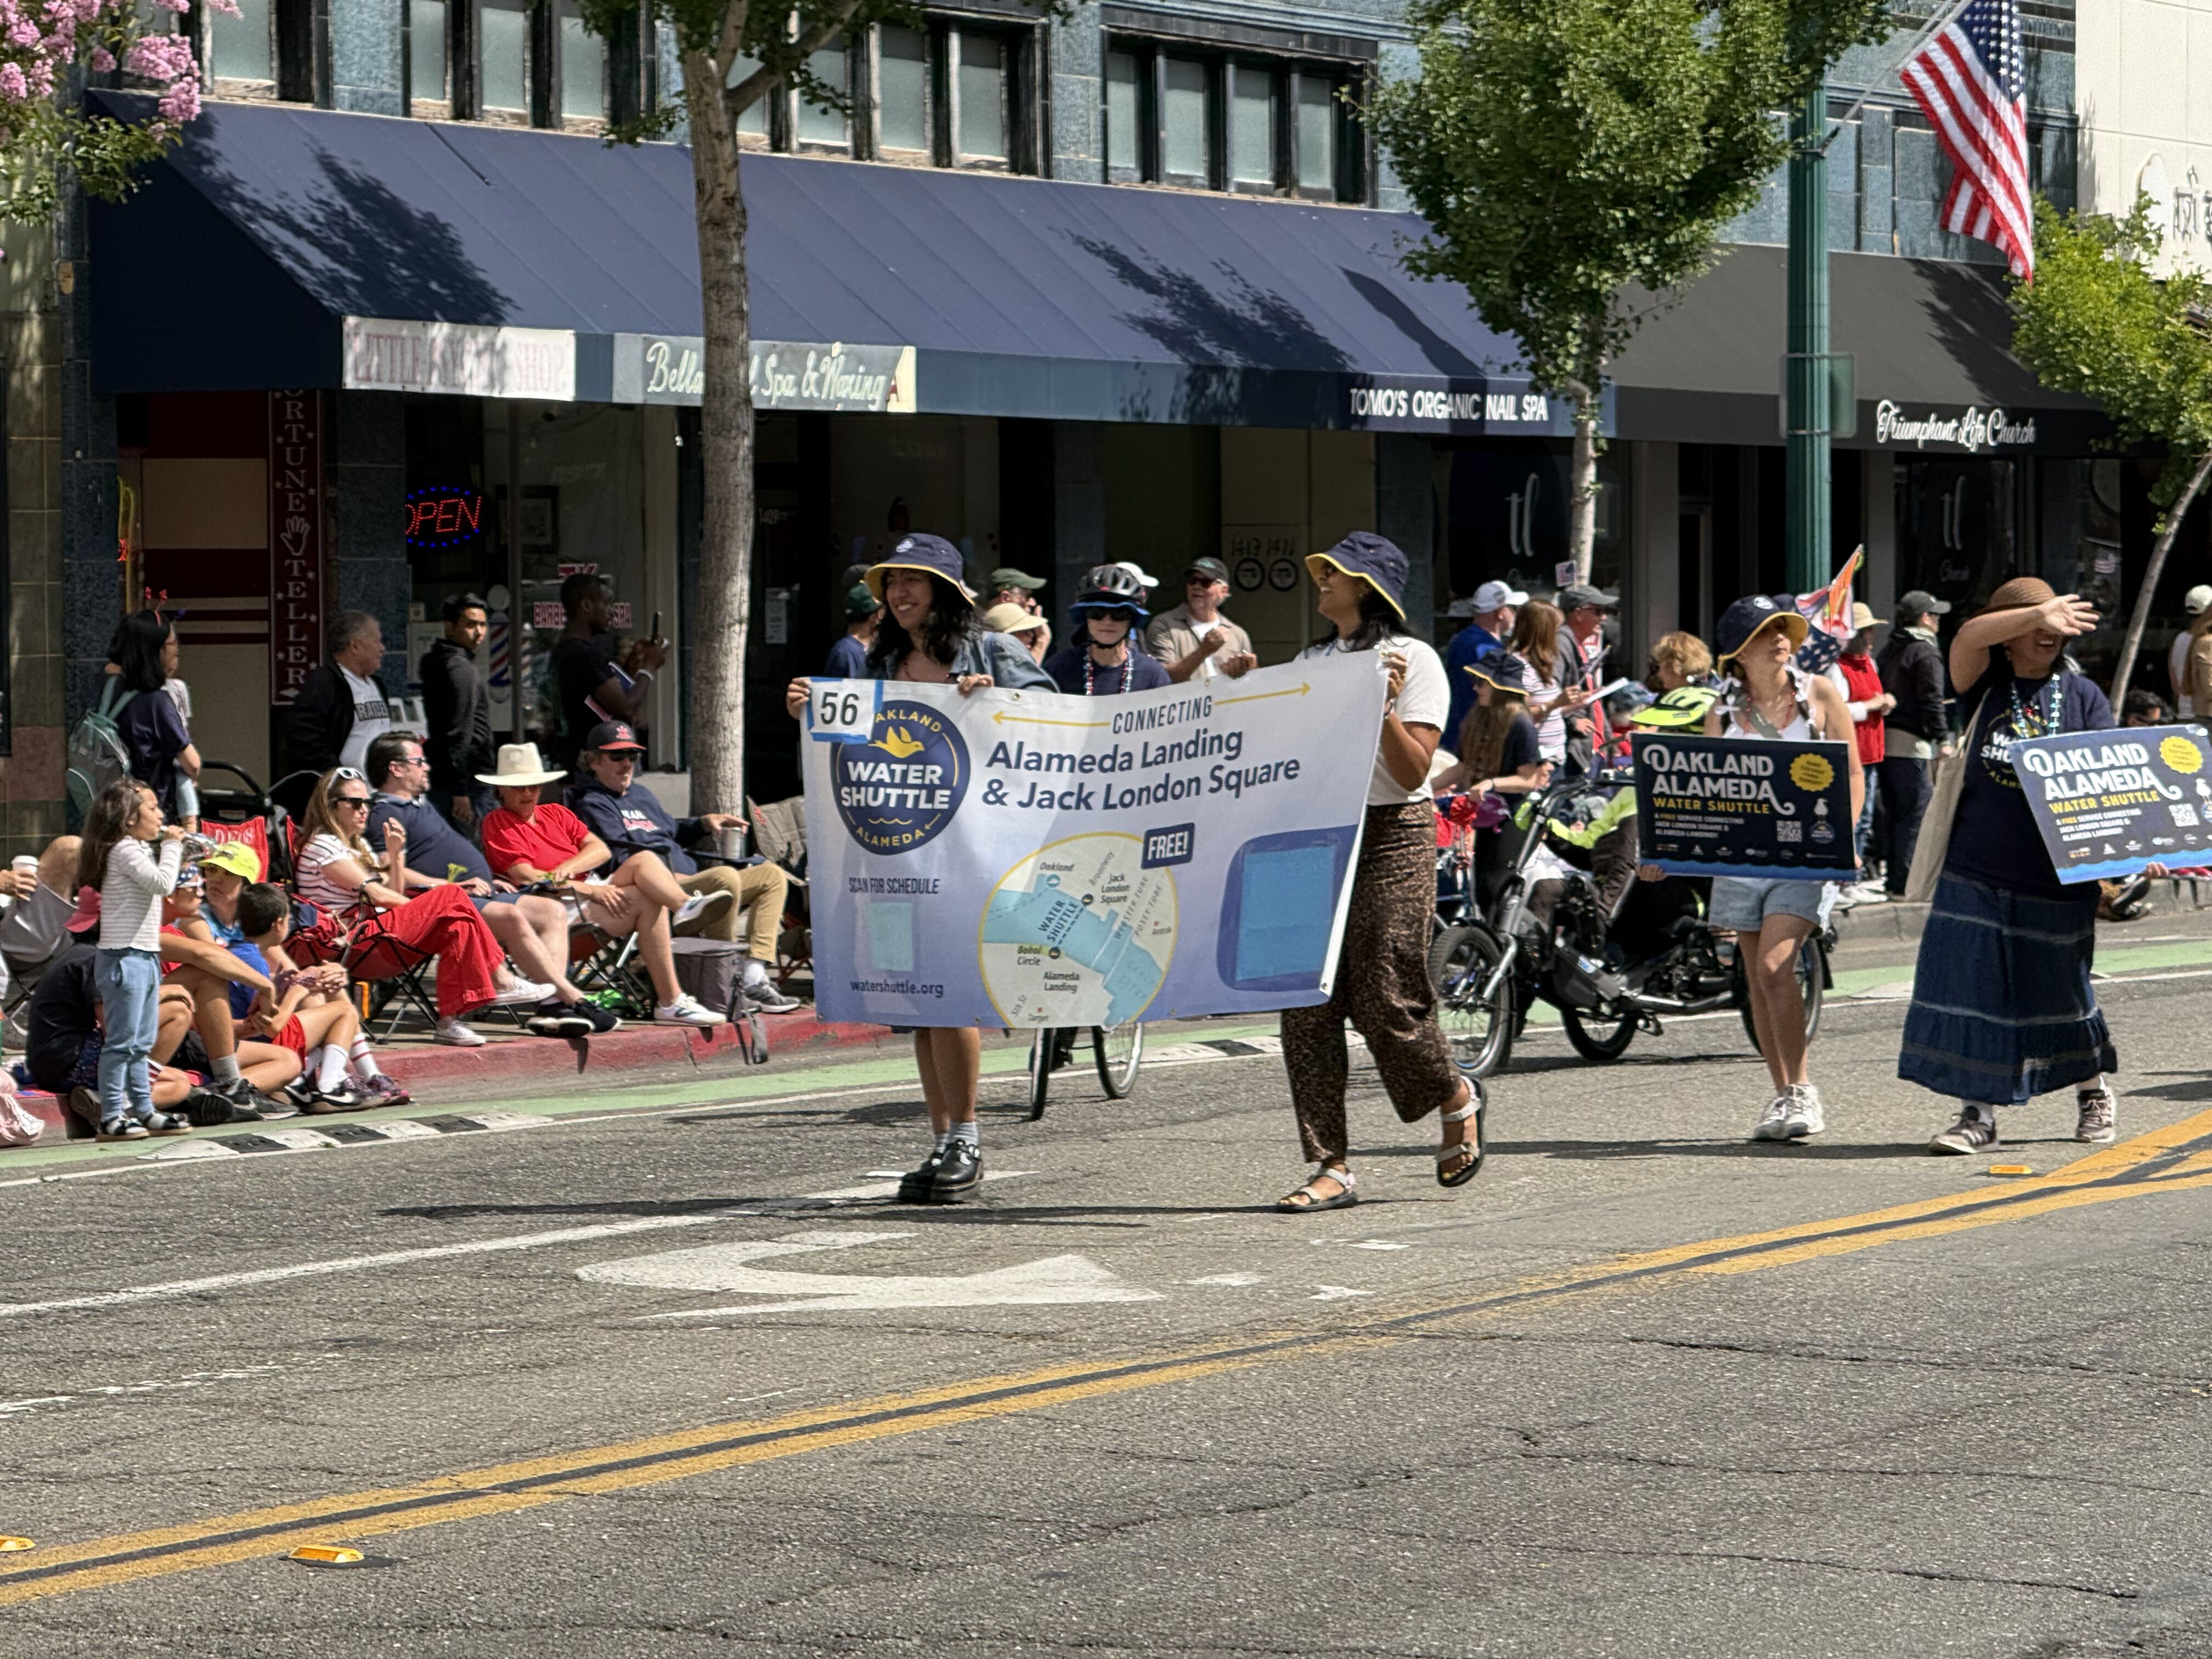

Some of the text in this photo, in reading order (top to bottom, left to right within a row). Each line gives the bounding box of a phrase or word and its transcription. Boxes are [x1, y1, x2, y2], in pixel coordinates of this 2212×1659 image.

[761, 353, 797, 405] Spa
[801, 350, 820, 398] &
[820, 354, 888, 410] Waxing
[1350, 388, 1549, 421] TOMO'S ORGANIC NAIL SPA
[1876, 398, 2036, 453] Triumphant Life Church
[283, 558, 307, 685] TELLER
[820, 691, 860, 726] 56
[874, 709, 943, 732] AKLAND
[1112, 695, 1212, 735] CONNECTING
[985, 727, 1243, 774] Alameda Landing
[1642, 743, 1774, 777] OAKLAND
[2022, 742, 2149, 777] OAKLAND
[847, 761, 944, 785] WATER
[981, 758, 1301, 811] & Jack London Square
[2044, 766, 2183, 801] ALAMEDA
[840, 786, 952, 810] SHUTTLE
[1652, 774, 1796, 816] ALAMEDA
[1652, 797, 1770, 815] WATER SHUTTLE
[2048, 789, 2160, 815] WATER SHUTTLE
[856, 826, 926, 848] ALAMEDA
[1147, 831, 1189, 861] FREE!
[1040, 861, 1075, 872] Oakland
[1088, 849, 1115, 887] Broadway
[1108, 873, 1125, 884] Jack
[849, 877, 941, 894] SCAN FOR SCHEDULE
[1100, 895, 1127, 904] Square
[1101, 884, 1130, 893] London
[1038, 900, 1066, 933] WATER
[1047, 901, 1079, 942] SHUTTLE
[1017, 956, 1041, 966] Circle
[1043, 971, 1080, 981] Alameda
[850, 978, 944, 998] watershuttle.org
[1043, 982, 1077, 994] Landing
